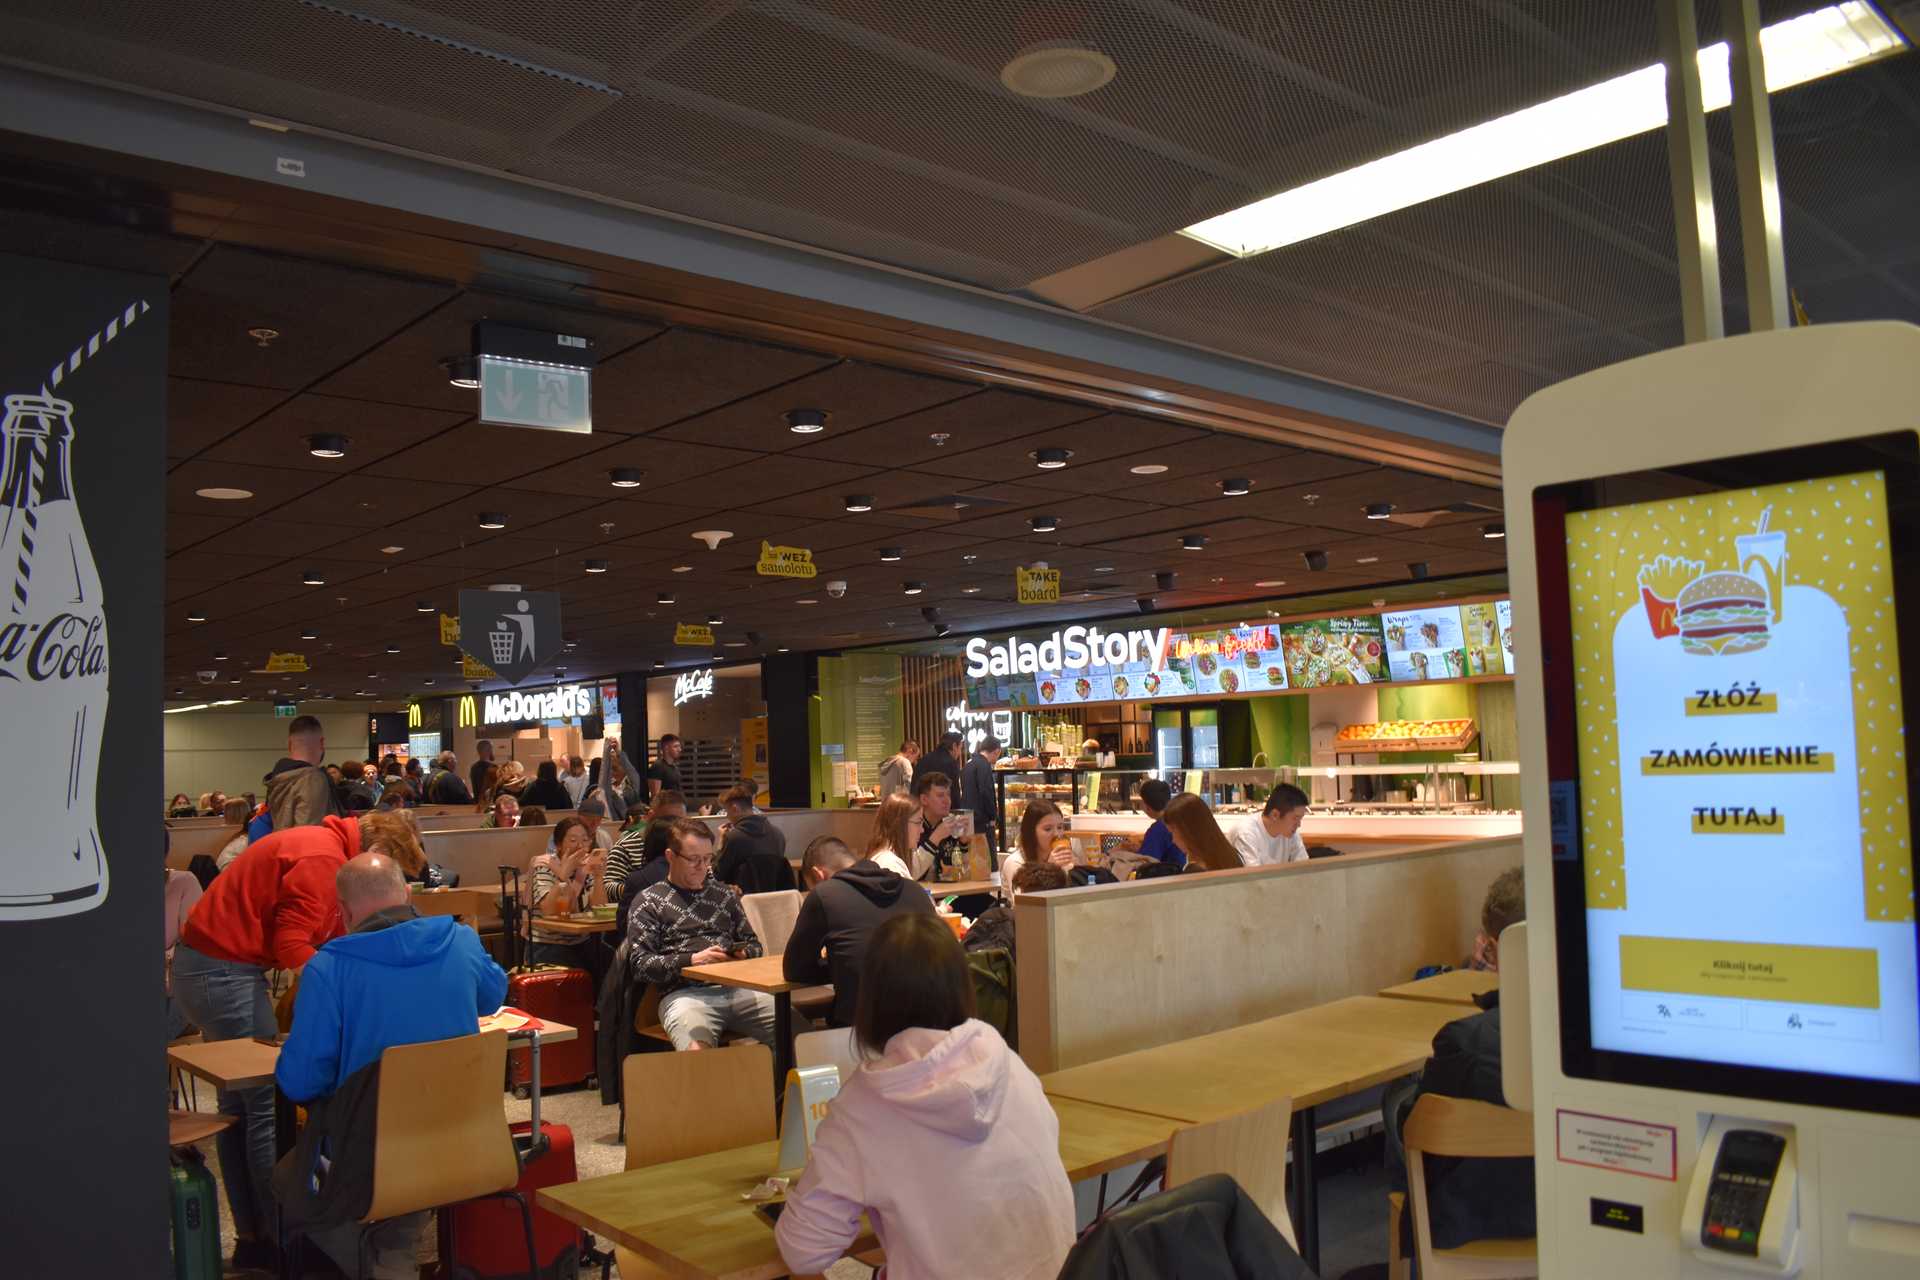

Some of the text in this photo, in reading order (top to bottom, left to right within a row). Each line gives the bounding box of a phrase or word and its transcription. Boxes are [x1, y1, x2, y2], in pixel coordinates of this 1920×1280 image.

[1029, 571, 1058, 583] TAKE
[1021, 585, 1058, 600] board
[484, 685, 591, 725] McDonald's
[1696, 681, 1762, 709] ZŁÓŻ
[1650, 741, 1819, 768] ZAMÓWIENIE
[1693, 807, 1778, 827] TUTAJ
